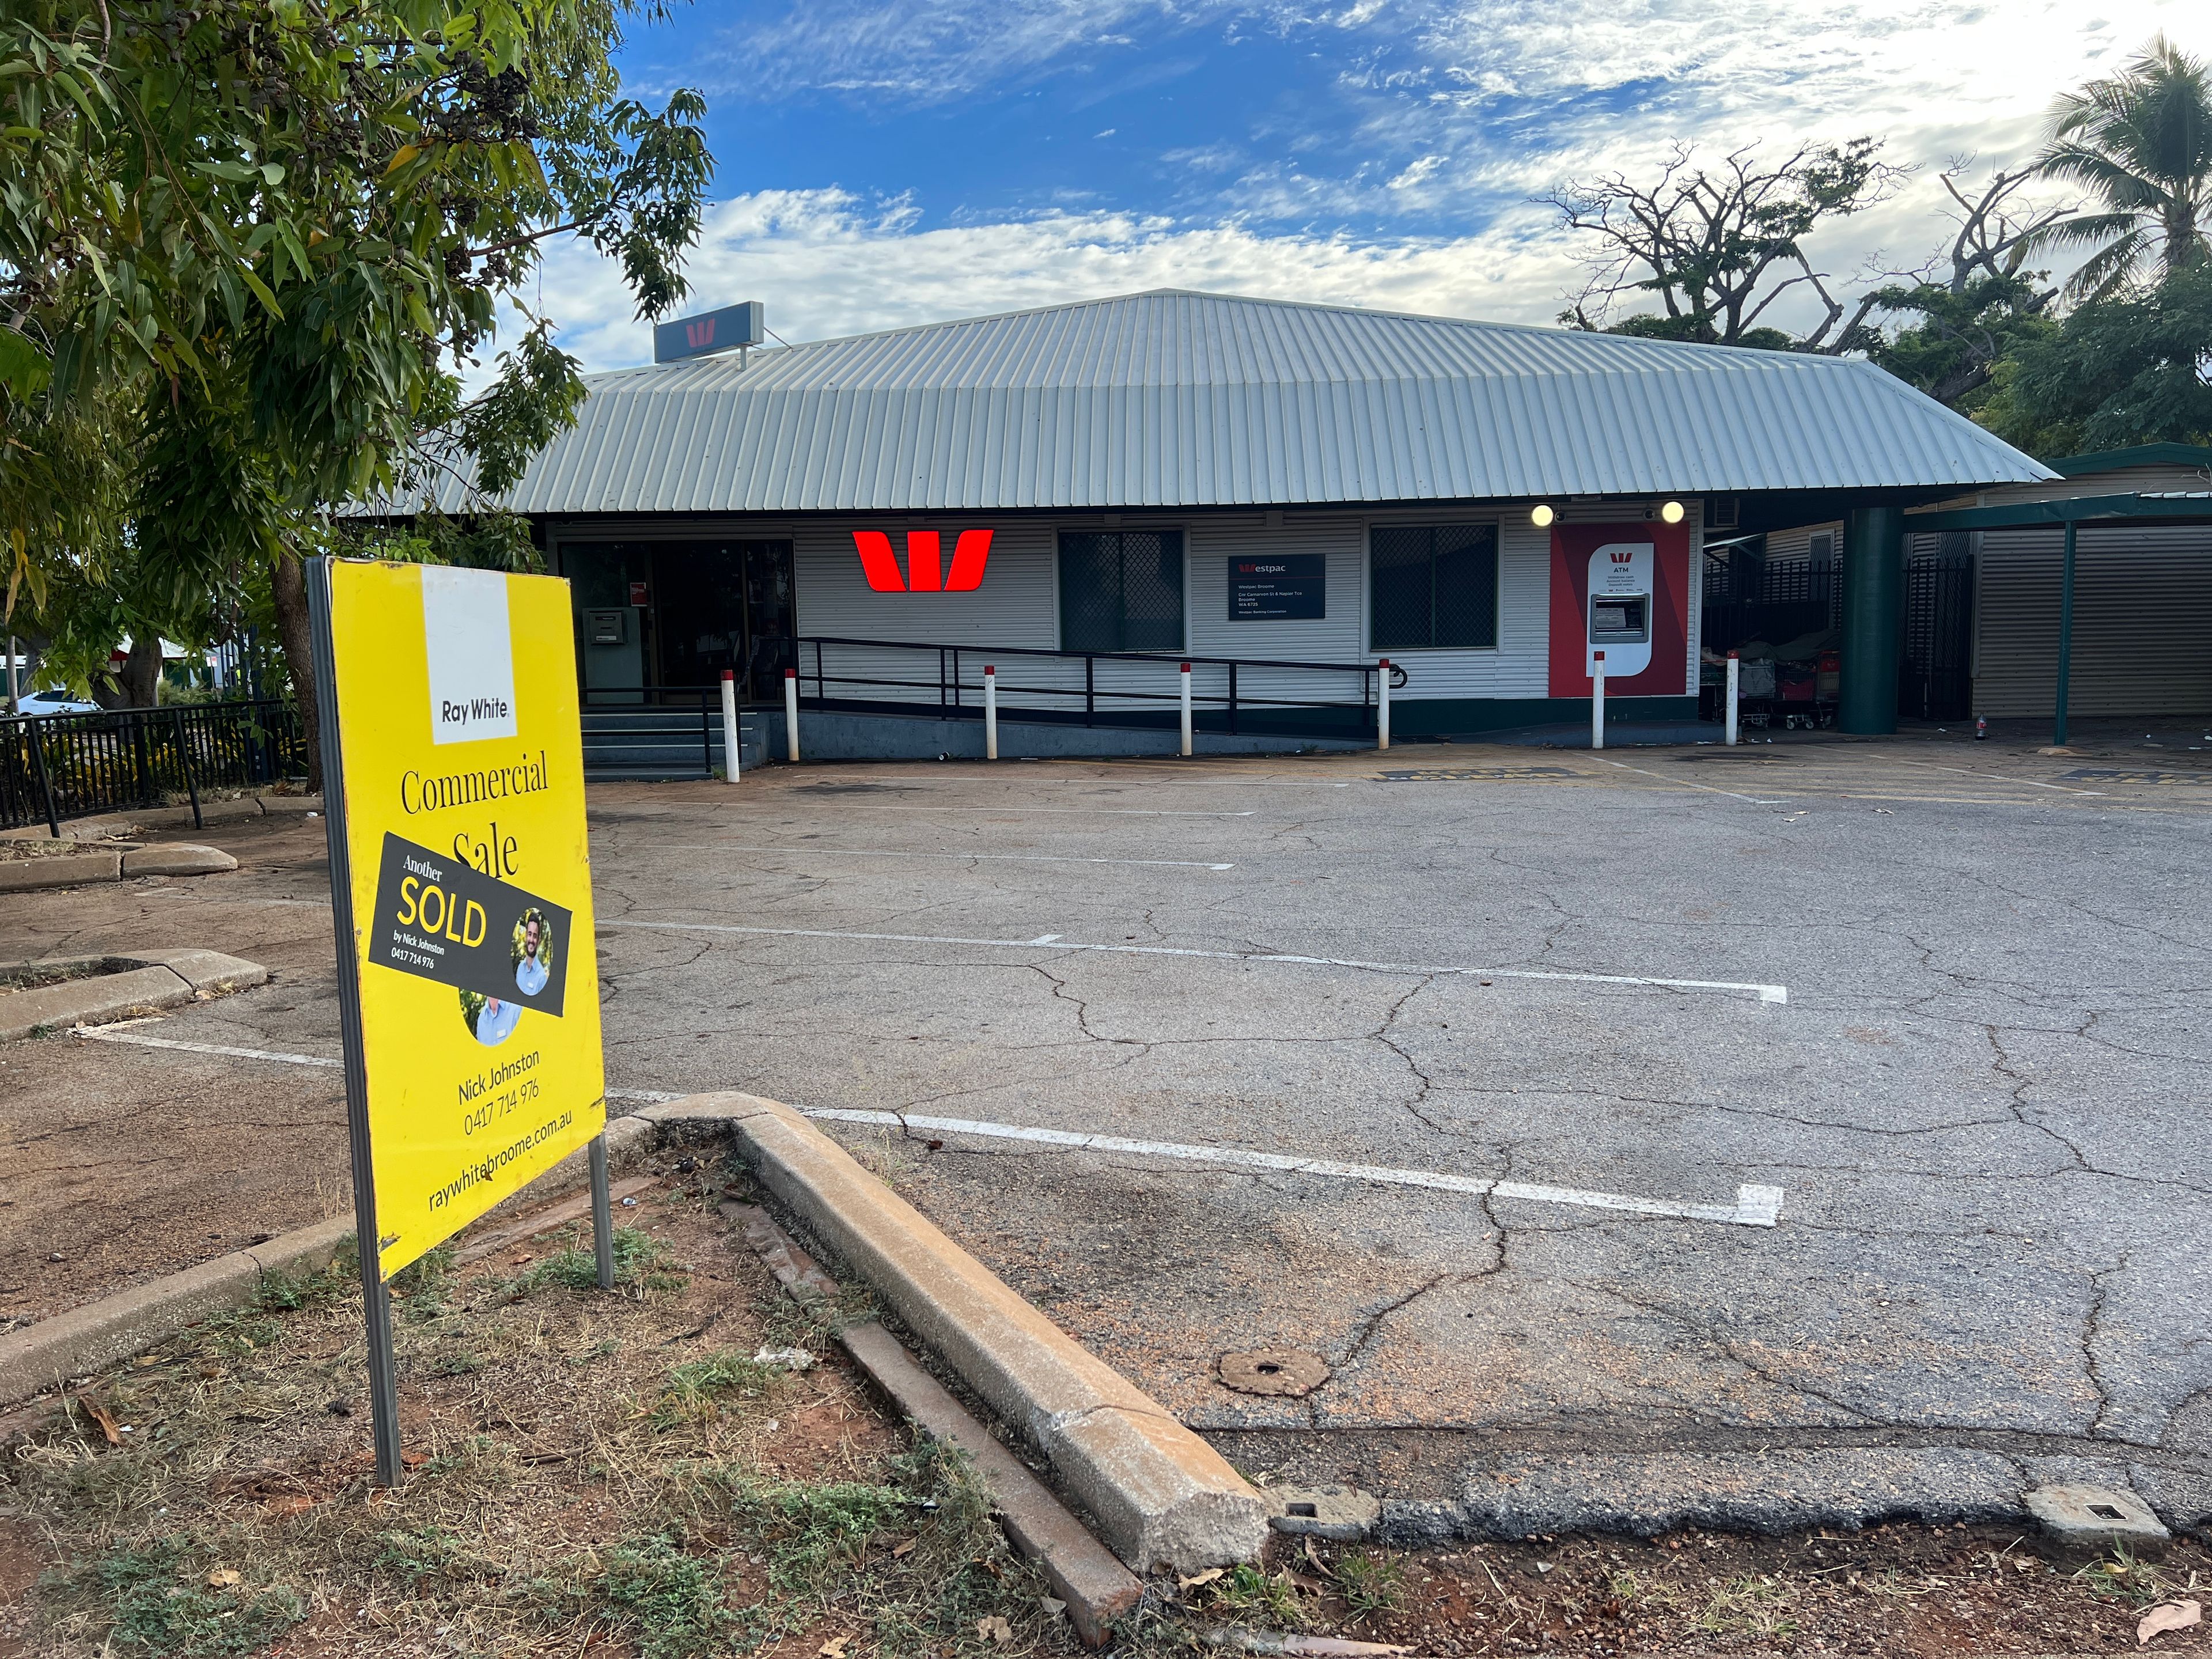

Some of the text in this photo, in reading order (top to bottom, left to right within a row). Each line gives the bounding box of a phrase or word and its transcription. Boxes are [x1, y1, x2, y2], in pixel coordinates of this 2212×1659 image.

[1238, 564, 1286, 573] Westpac
[442, 700, 469, 726] Ray
[402, 750, 549, 815] Commercial
[403, 854, 443, 882] Another
[453, 822, 519, 878] Sale
[396, 876, 487, 948] SOLD
[391, 946, 435, 969] 0417 714 976
[393, 929, 445, 956] by Nick Johnston
[458, 1050, 540, 1105] Nick Johnston
[464, 1078, 540, 1136] 0417 714 976
[429, 1109, 573, 1211] raywhitebroome.com.au
